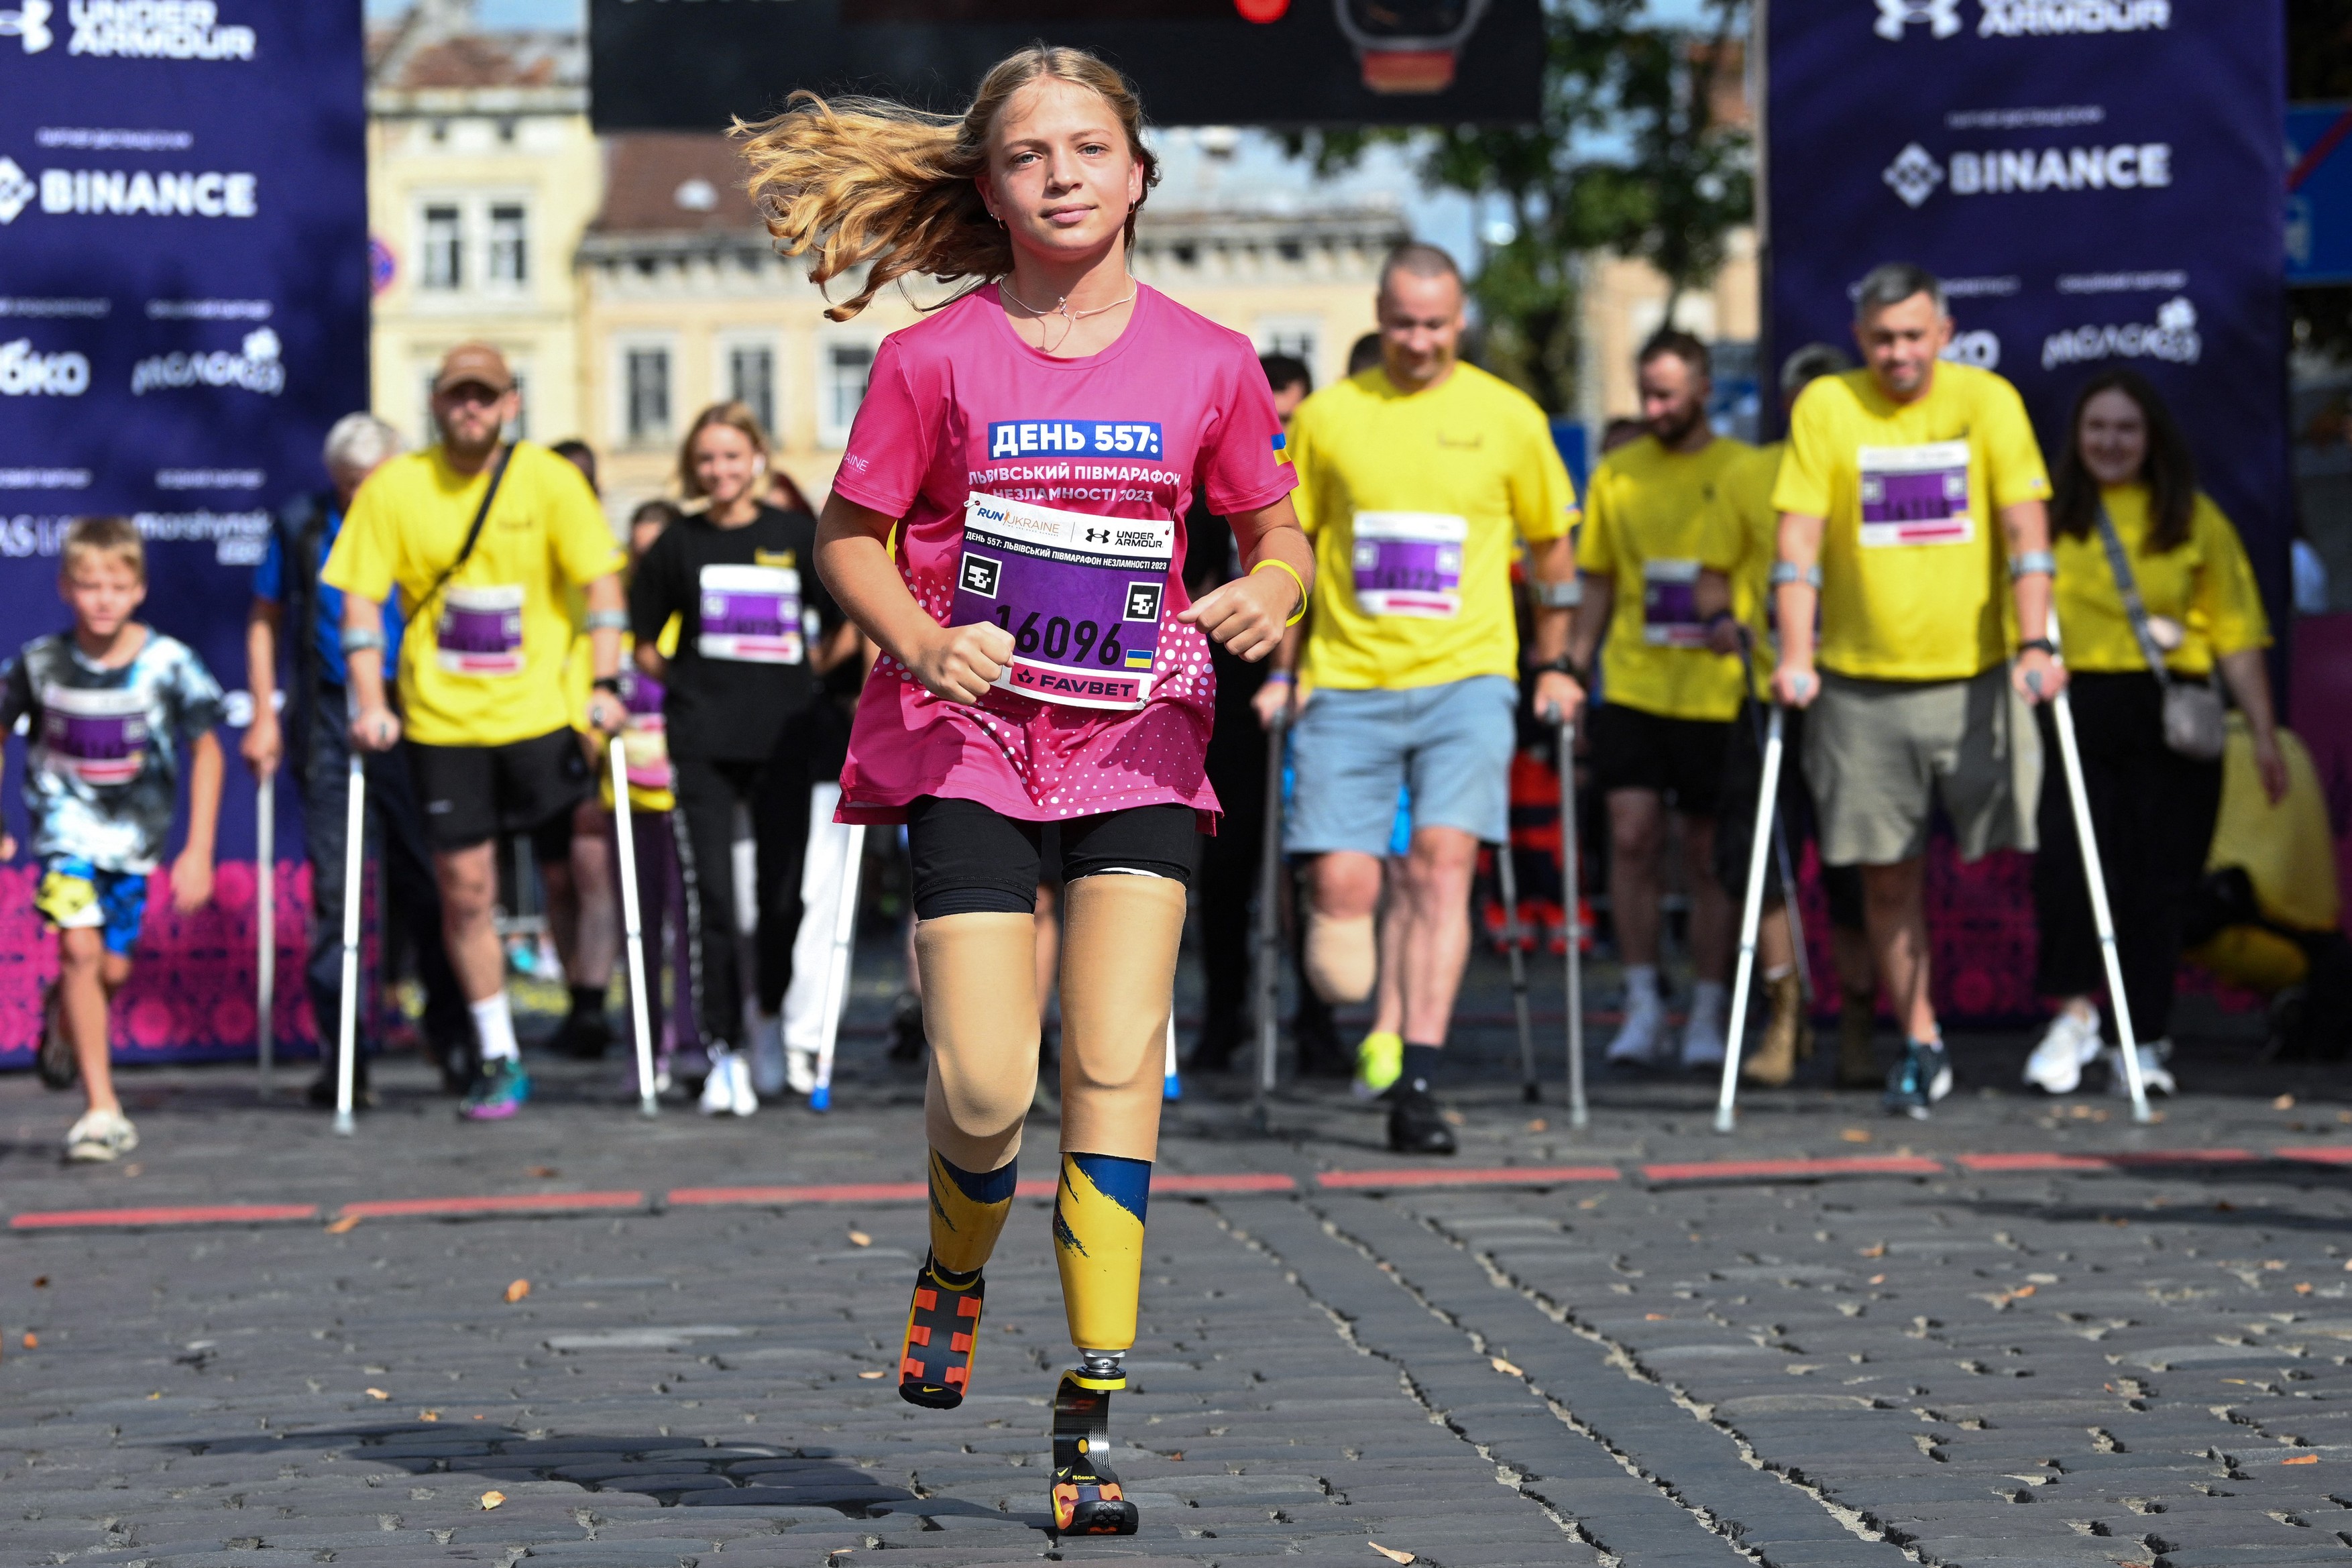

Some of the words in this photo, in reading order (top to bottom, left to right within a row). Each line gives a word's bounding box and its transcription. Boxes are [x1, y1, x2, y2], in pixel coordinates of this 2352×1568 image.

[69, 0, 217, 30] UNDER
[68, 25, 256, 60] ARMOUR
[1950, 144, 2172, 194] BINANCE
[40, 169, 257, 217] BINANCE
[993, 423, 1086, 457] ДЕНЬ
[1094, 425, 1159, 454] 557:
[968, 462, 1070, 486] ЛЬВІВСЬКИЙ
[1074, 465, 1181, 488] ПІВМАРАФОН
[993, 487, 1116, 502] НЕЗЛАМНОСТІ
[1118, 489, 1154, 503] 2023
[976, 507, 1005, 522] RUN
[1007, 515, 1060, 534] UKRAINE
[1117, 530, 1154, 540] UNDER
[965, 531, 985, 543] ДЕНЬ
[987, 537, 1003, 548] 557:
[1003, 541, 1050, 558] ЛЬВІВСЬКИЙ
[1052, 552, 1101, 565] ПІВМАРАФОН
[1103, 558, 1150, 569] НЕЗЛАМНОСТІ
[1151, 561, 1167, 570] 2023
[1115, 538, 1162, 548] ARMOUR
[996, 604, 1123, 665] 16096
[1040, 674, 1134, 697] FAVBET
